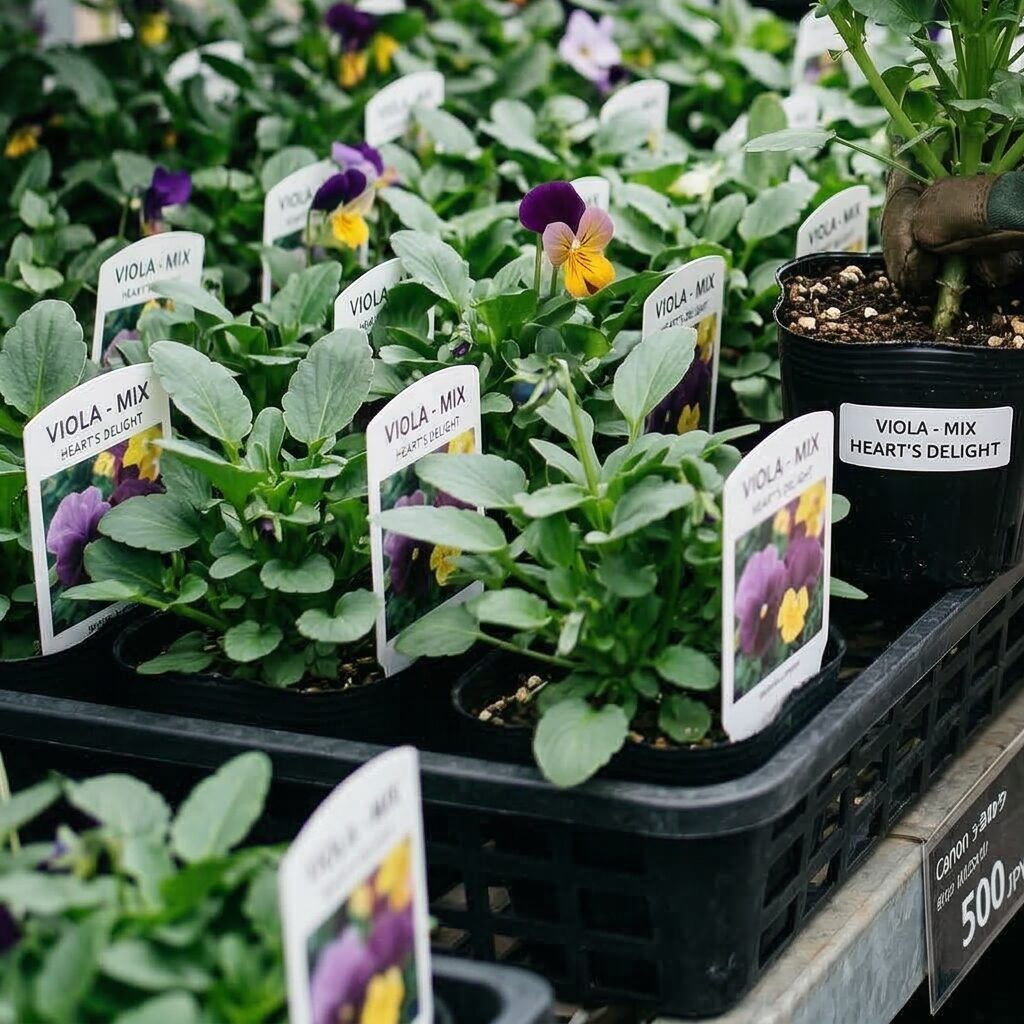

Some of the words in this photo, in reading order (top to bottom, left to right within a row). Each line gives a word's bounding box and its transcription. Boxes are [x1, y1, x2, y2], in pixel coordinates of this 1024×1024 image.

[115, 257, 156, 285] VIOLA
[166, 249, 192, 272] MIX
[349, 286, 389, 317] VIOLA
[655, 288, 688, 319] VIOLA
[696, 272, 716, 299] MIX
[45, 404, 103, 444] VIOLA
[116, 380, 150, 414] MIX
[103, 411, 144, 441] DELIGHT
[384, 405, 429, 444] VIOLA
[440, 384, 466, 415] MIX
[876, 419, 929, 436] VIOLA
[944, 421, 977, 436] MIX
[742, 459, 783, 499] VIOLA
[794, 432, 819, 465] MIX
[850, 439, 922, 459] HEART'S
[927, 442, 1001, 459] DELIGHT
[936, 832, 969, 881] Canon
[961, 860, 1006, 948] 500
